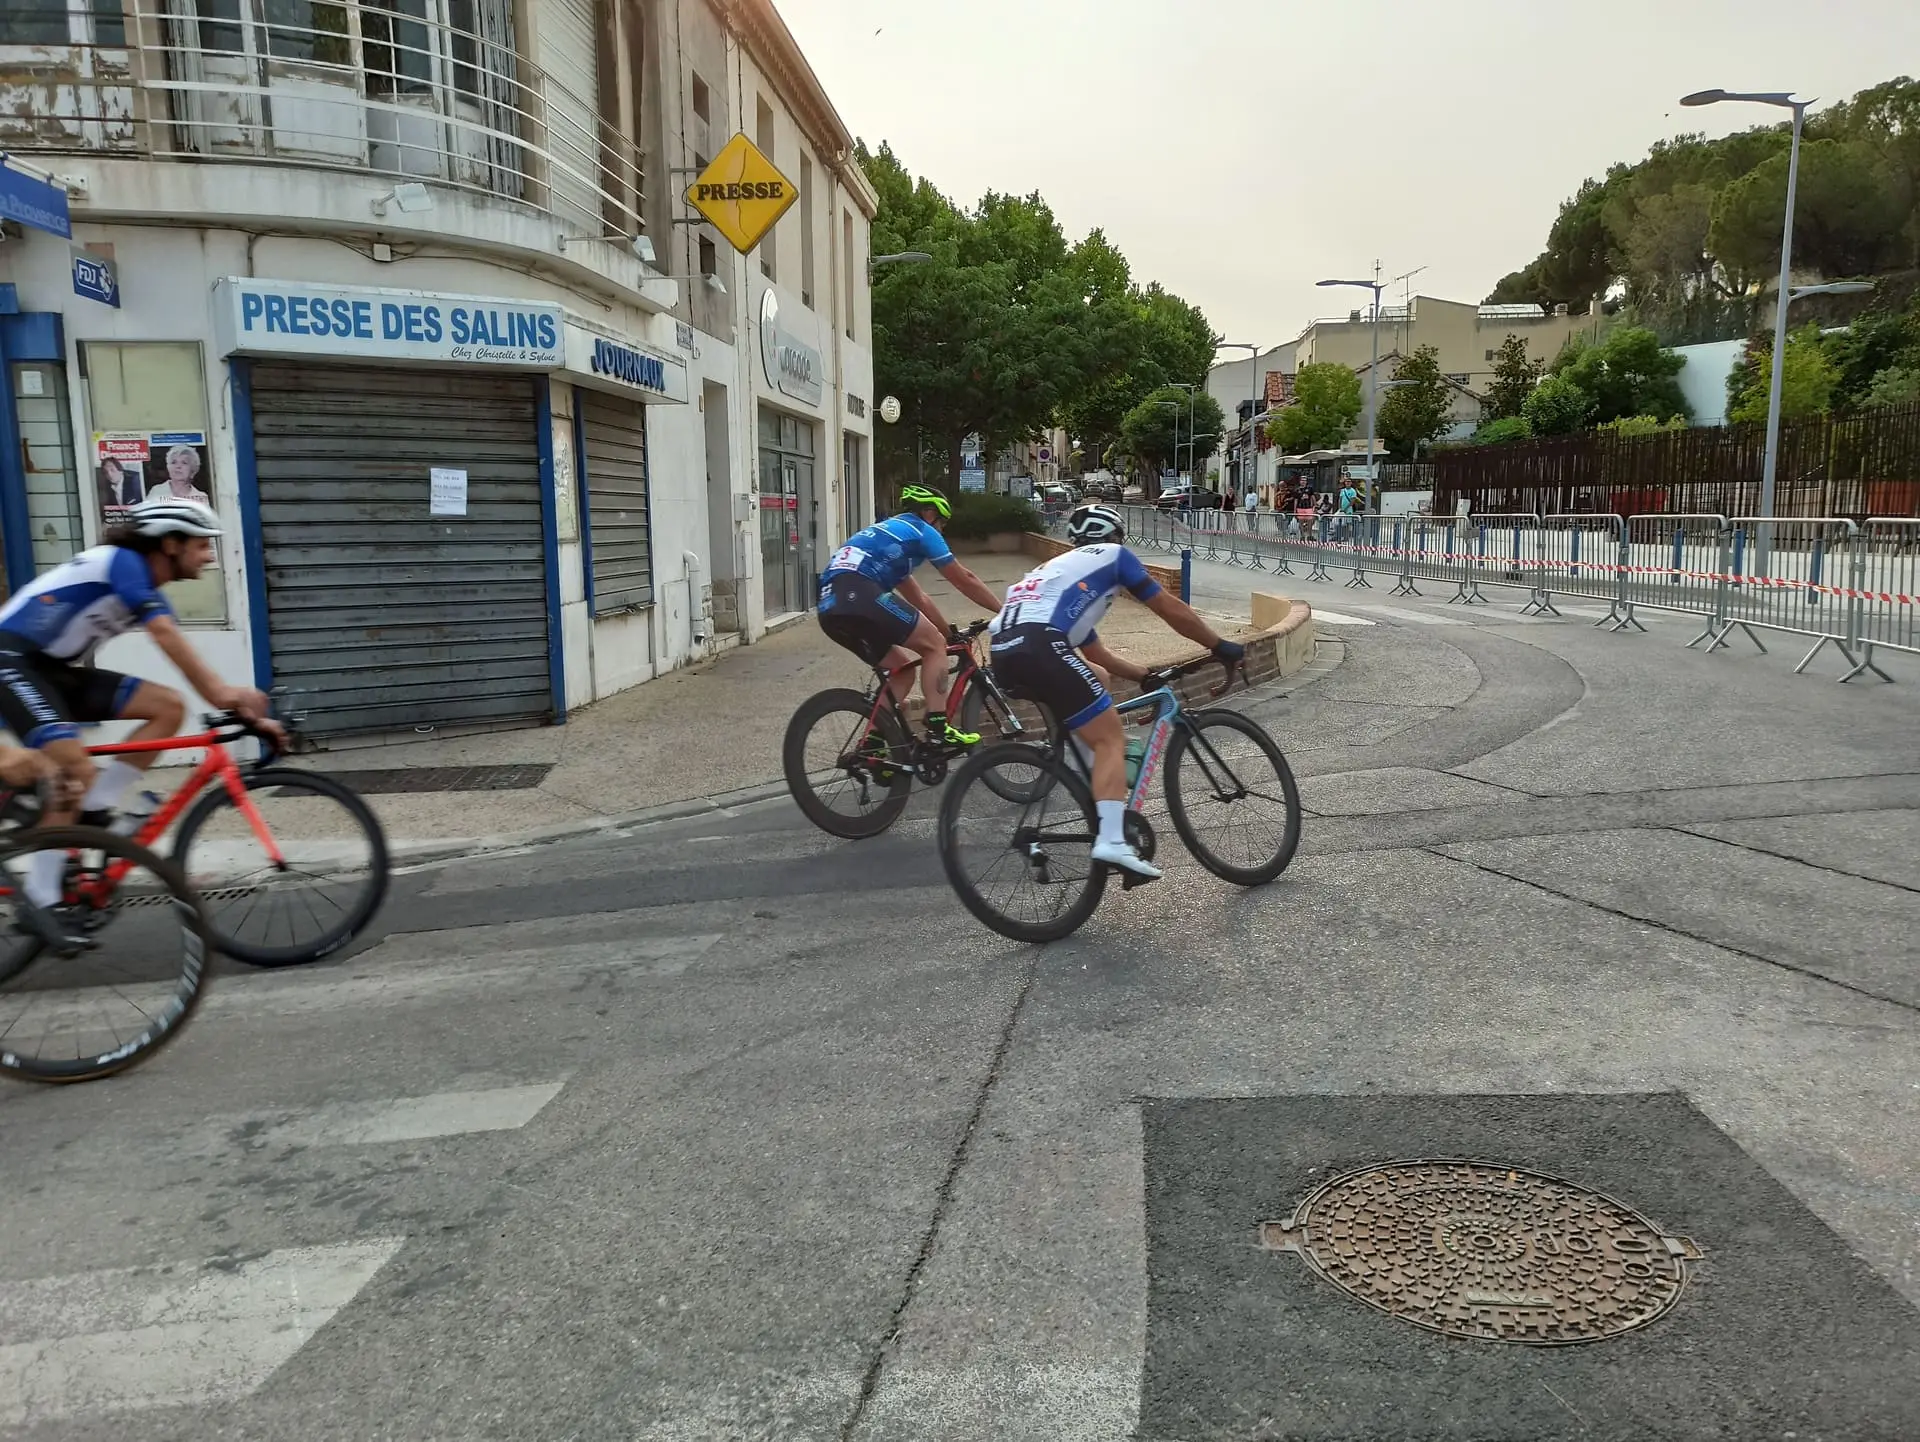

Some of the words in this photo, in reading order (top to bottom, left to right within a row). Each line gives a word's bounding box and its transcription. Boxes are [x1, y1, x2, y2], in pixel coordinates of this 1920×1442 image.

[696, 182, 783, 201] PRESSE
[10, 194, 69, 230] Provence
[78, 263, 97, 284] FDJ
[241, 292, 374, 339] PRESSE
[381, 303, 443, 343] DES
[450, 308, 556, 349] SALINS
[451, 346, 472, 360] Chez
[475, 347, 516, 361] Christelle
[519, 350, 526, 360] &
[529, 351, 556, 362] Sylvie
[590, 338, 666, 392] JOURNAUX
[106, 441, 141, 451] France
[840, 546, 852, 560] 3
[1062, 654, 1105, 696] CAVAILLON
